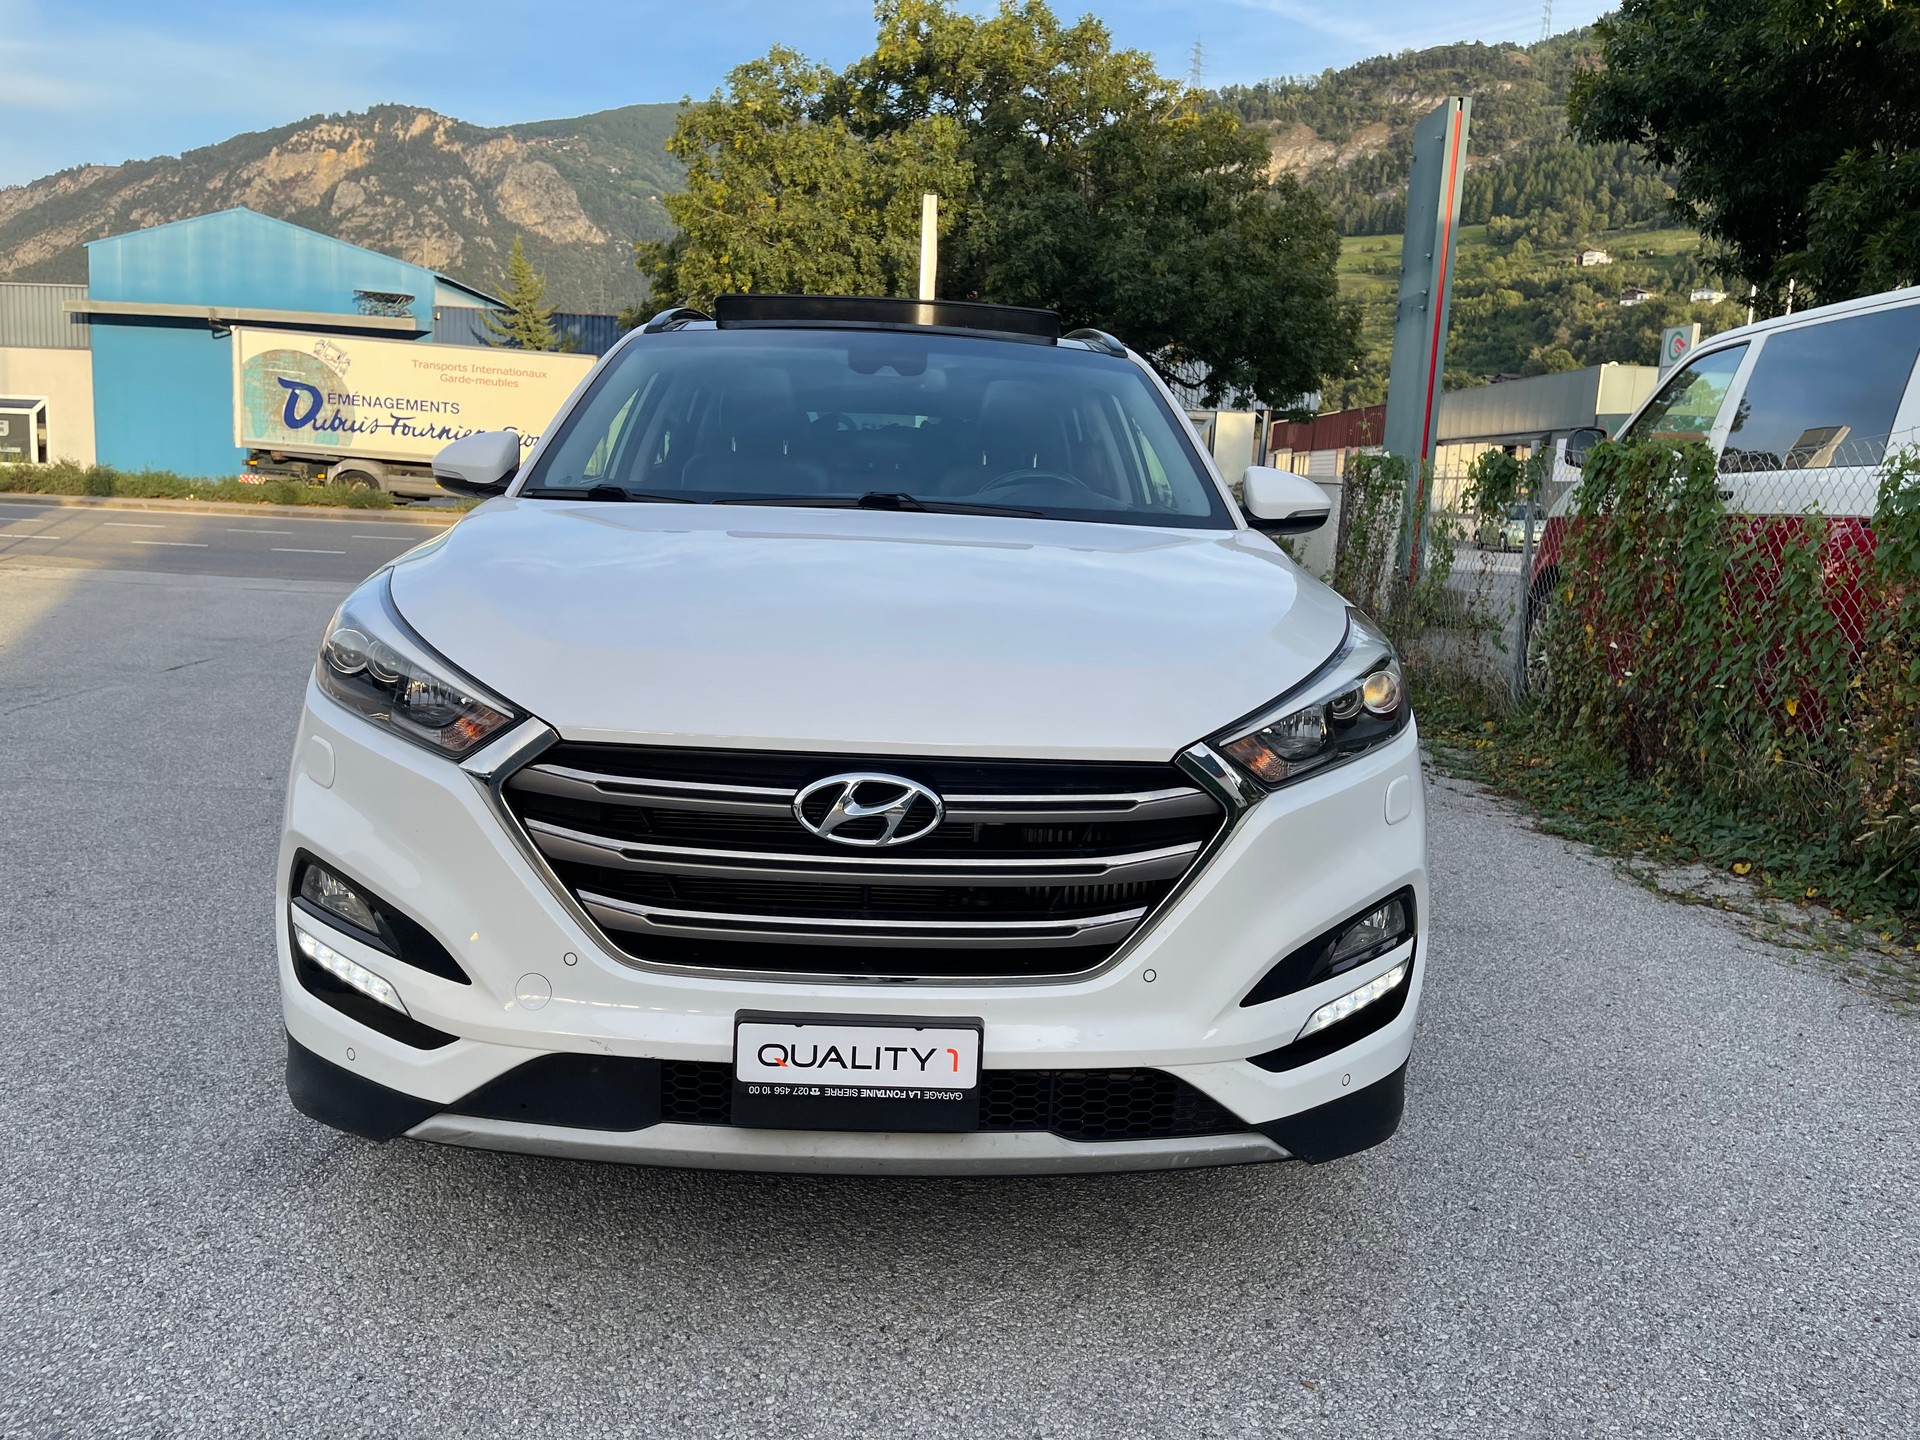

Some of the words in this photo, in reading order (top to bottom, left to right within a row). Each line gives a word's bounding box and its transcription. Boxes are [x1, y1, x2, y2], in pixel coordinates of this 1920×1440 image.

[411, 359, 468, 373] Transports
[471, 364, 548, 378] Internationaux
[439, 373, 519, 388] Garde-meubles
[757, 1043, 938, 1072] QUALITY
[748, 1085, 760, 1095] 00
[762, 1086, 771, 1095] 10
[774, 1086, 791, 1095] 456
[792, 1086, 809, 1095] 027
[824, 1087, 858, 1097] SIERRE
[860, 1088, 906, 1099] FONTAINE
[908, 1090, 921, 1099] LA
[923, 1090, 963, 1100] GARAGE
